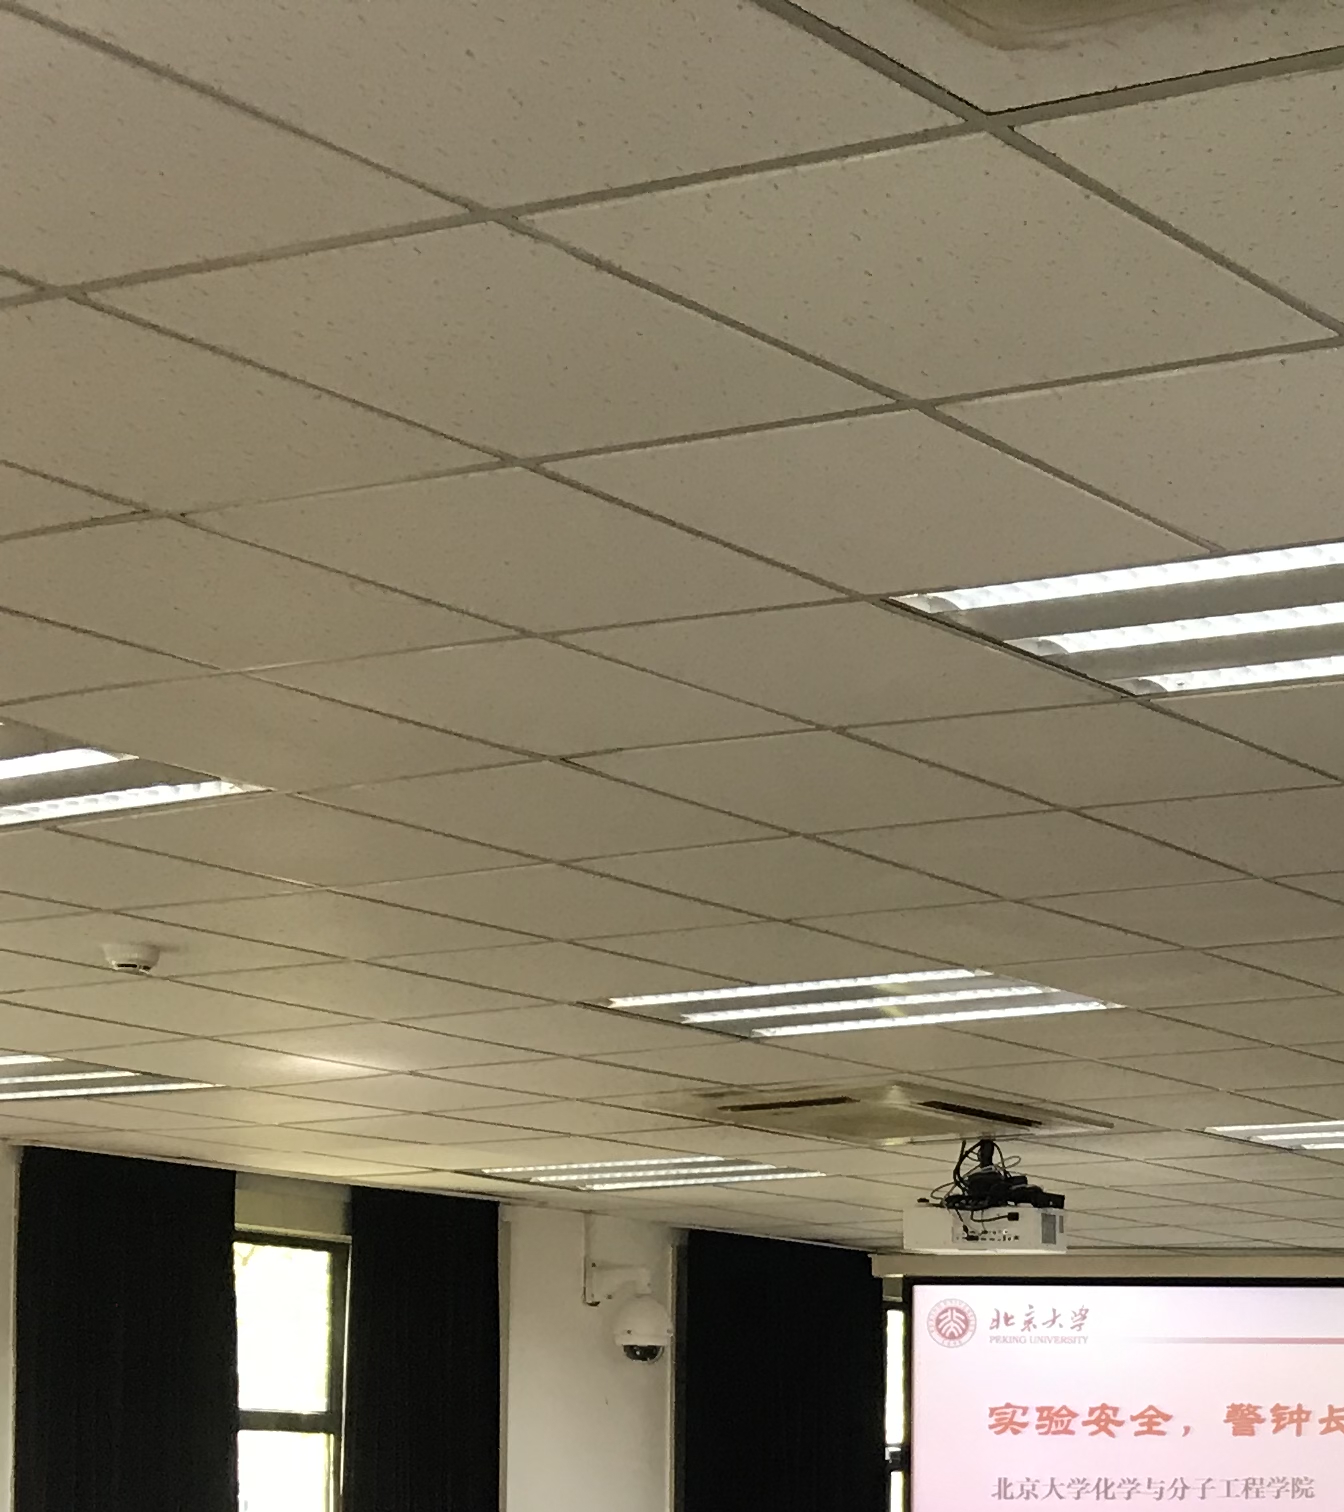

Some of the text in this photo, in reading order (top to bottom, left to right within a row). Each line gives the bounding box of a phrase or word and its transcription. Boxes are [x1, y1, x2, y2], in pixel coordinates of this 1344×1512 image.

[989, 1304, 1090, 1333] 北京大学
[989, 1335, 1089, 1345] PEKING UNIVERSITY
[991, 1476, 1315, 1501] 北京大学化学与分子工程学院
